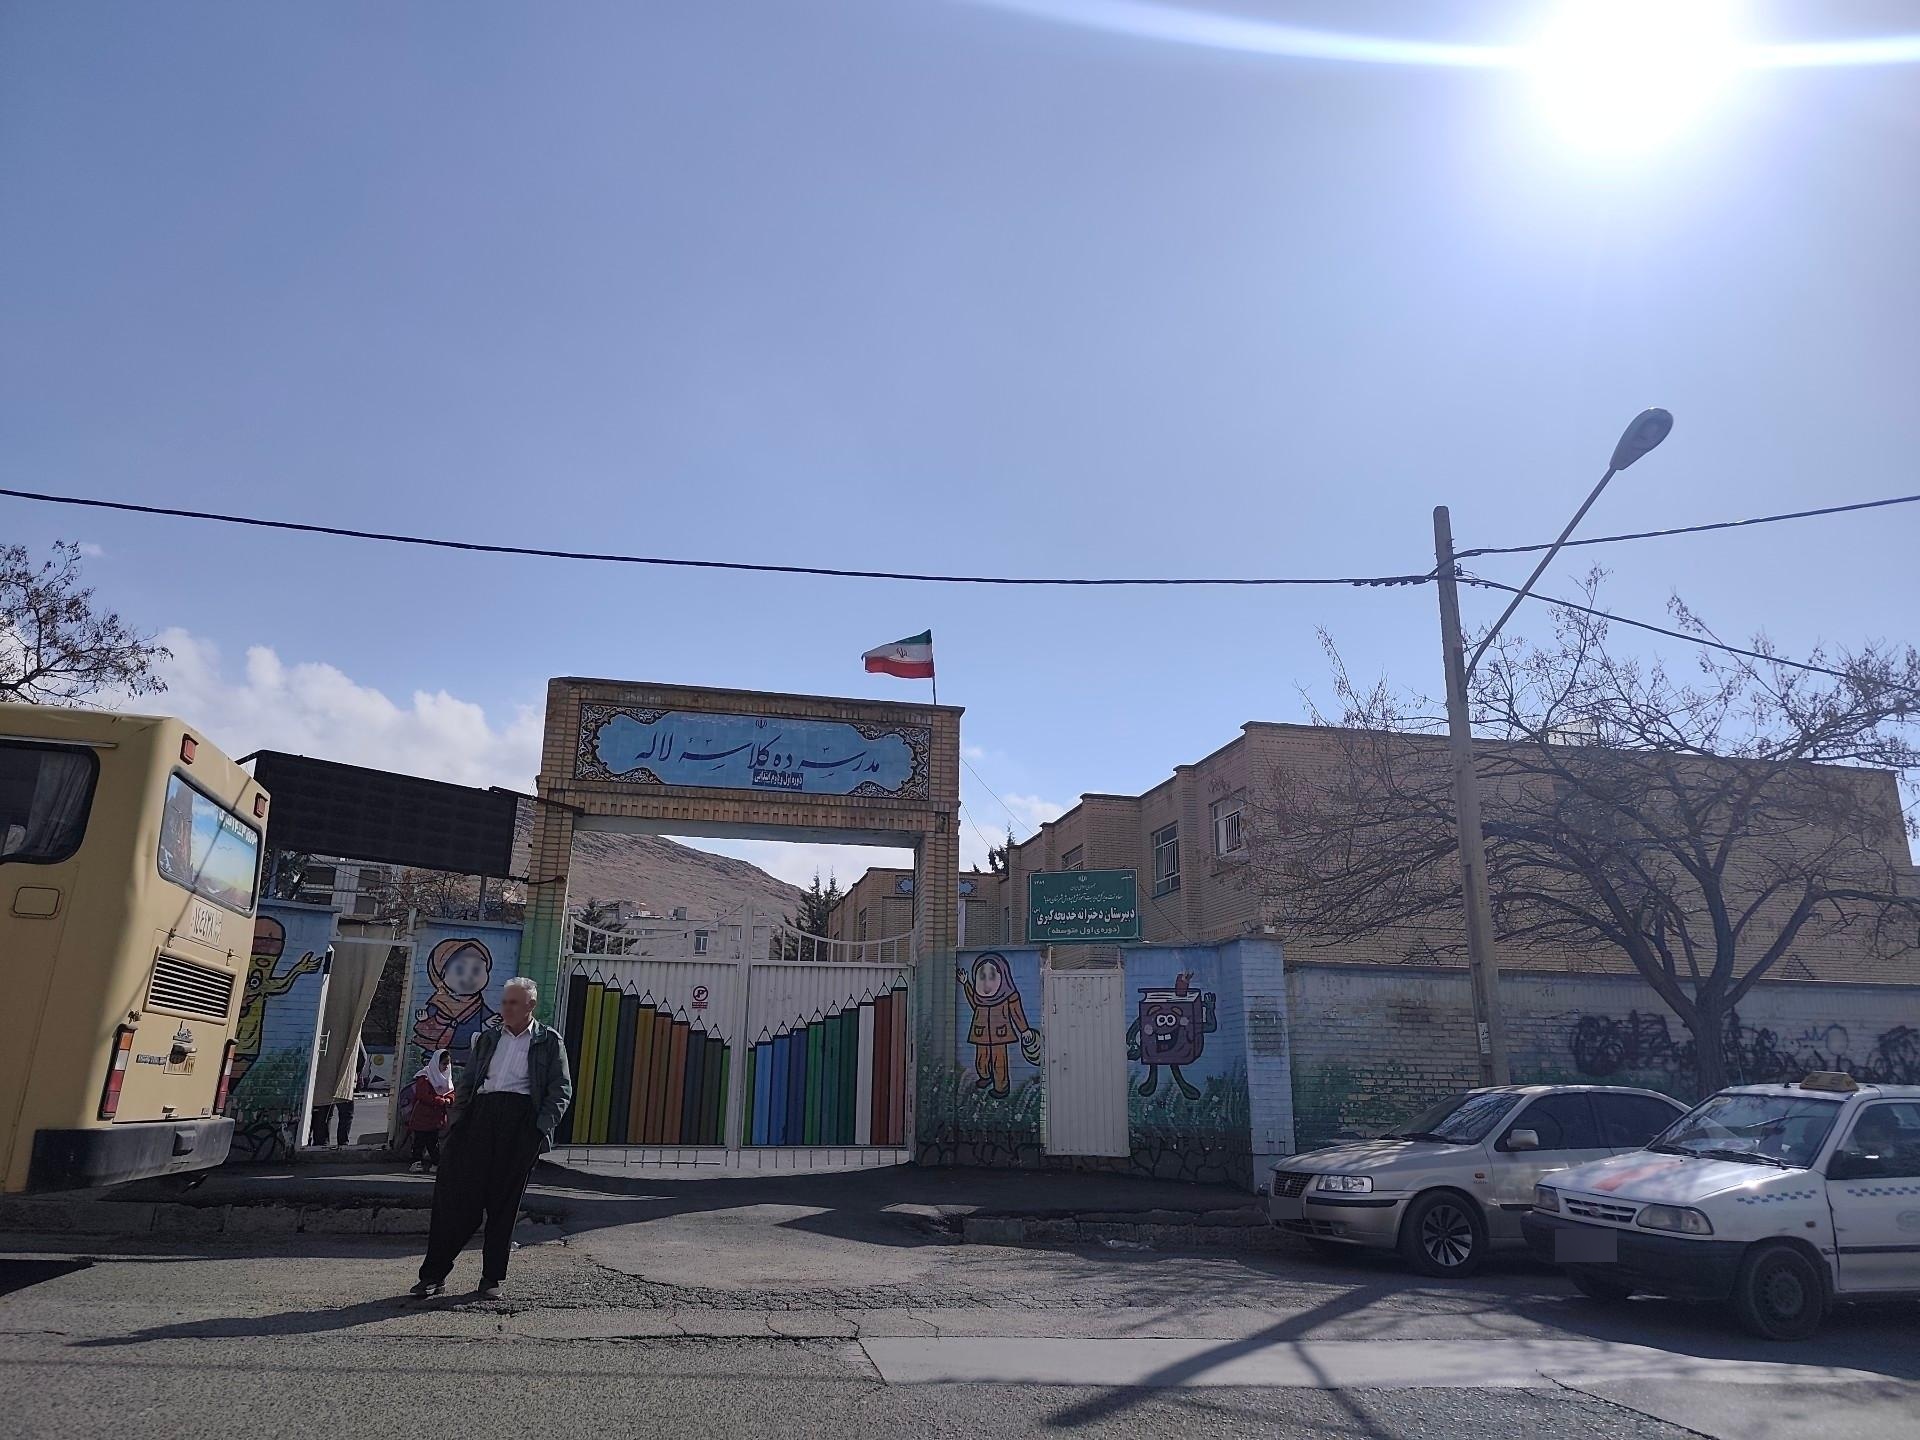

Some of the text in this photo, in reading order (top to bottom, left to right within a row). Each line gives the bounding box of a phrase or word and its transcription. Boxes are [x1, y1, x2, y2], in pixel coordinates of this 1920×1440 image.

[634, 731, 673, 761] لاله
[774, 753, 793, 769] ده
[798, 748, 880, 775] مدرسه
[1036, 909, 1054, 925] کبری
[1054, 908, 1077, 923] خدیجه
[1078, 907, 1103, 923] دخترانه
[1105, 907, 1135, 923] دبیرستان
[1080, 926, 1094, 935] اول
